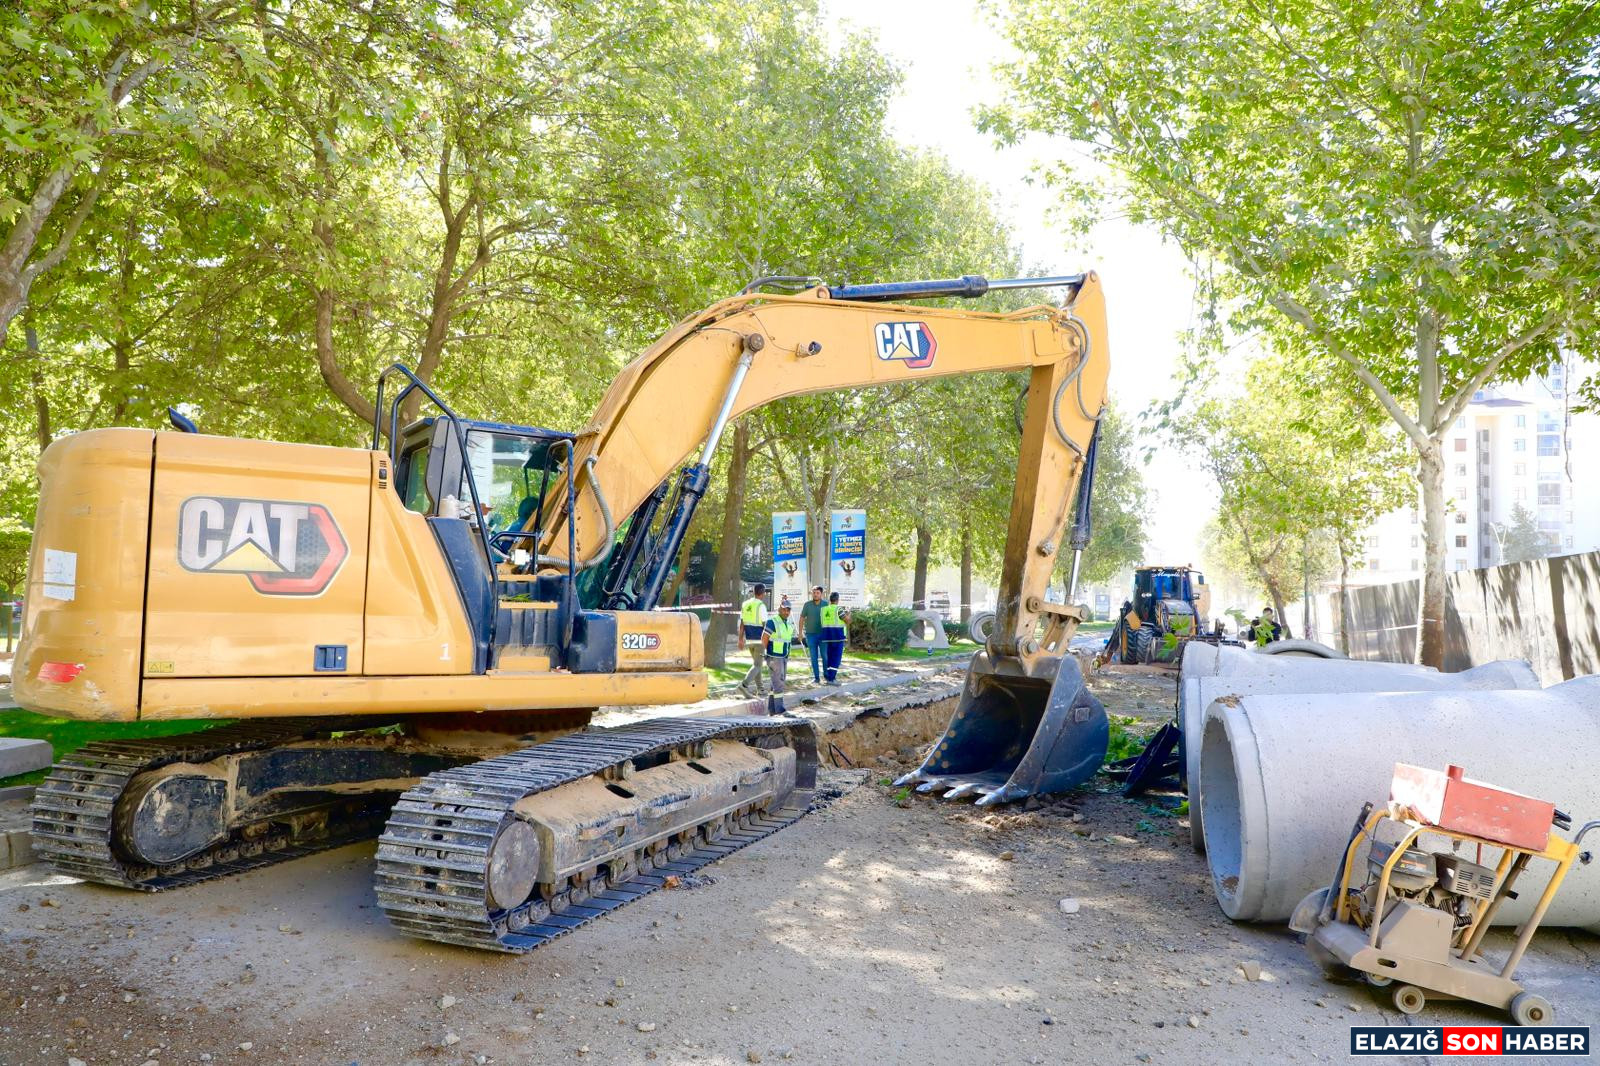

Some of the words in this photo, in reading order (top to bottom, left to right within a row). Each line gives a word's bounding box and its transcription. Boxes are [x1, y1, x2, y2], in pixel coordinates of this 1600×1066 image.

[875, 322, 921, 360] CAT
[181, 498, 309, 573] CAT
[440, 643, 451, 660] 1
[622, 634, 647, 649] 320
[647, 637, 657, 646] GC
